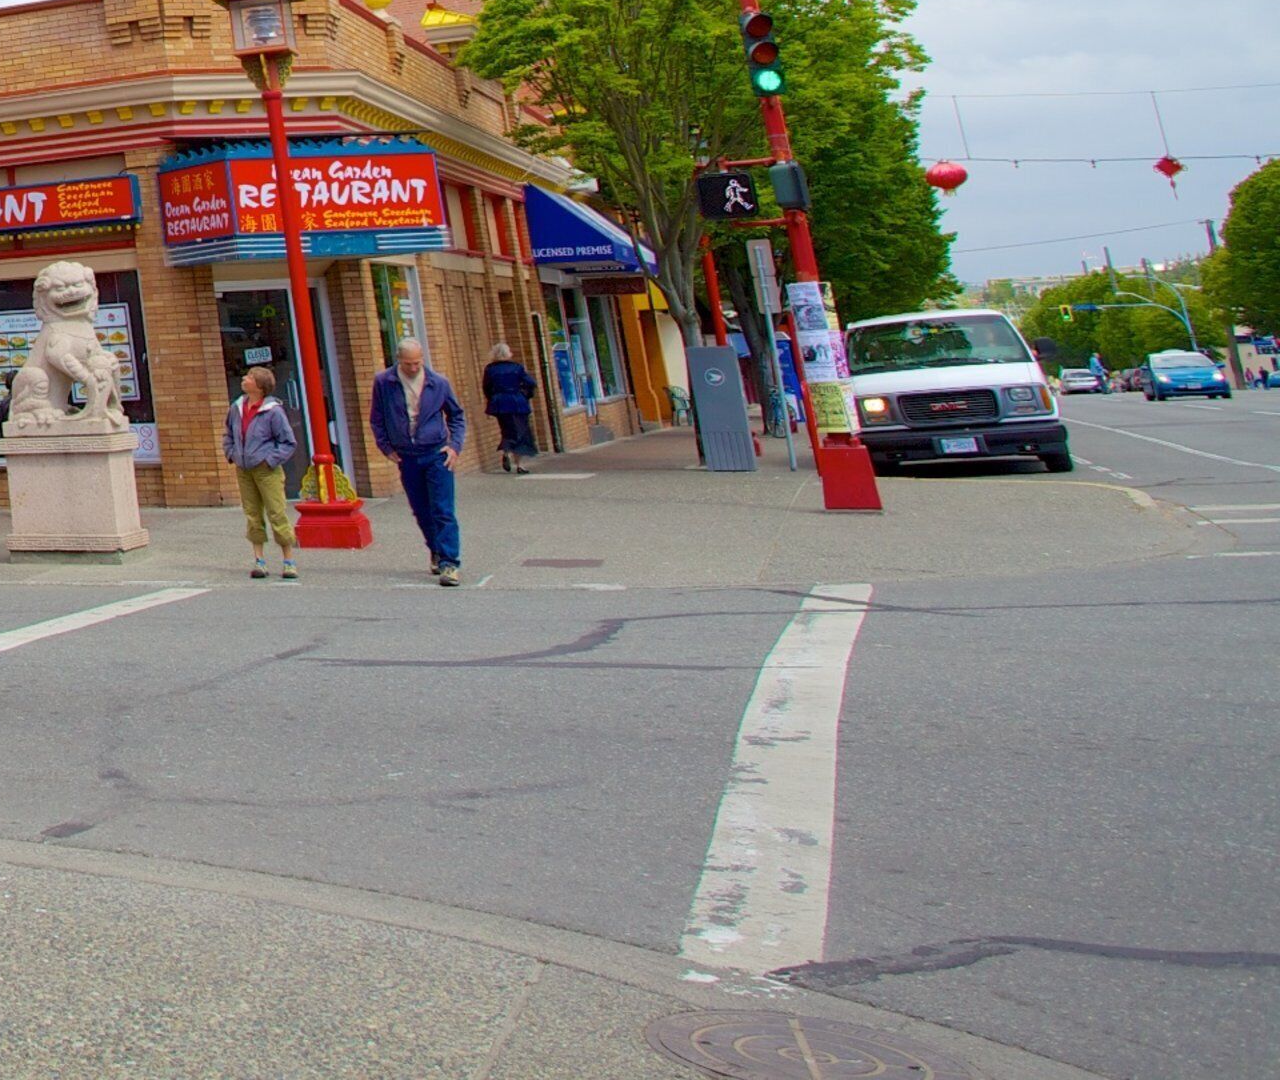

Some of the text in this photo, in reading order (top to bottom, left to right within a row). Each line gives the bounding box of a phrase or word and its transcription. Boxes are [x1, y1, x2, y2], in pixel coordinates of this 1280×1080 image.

[329, 160, 391, 181] Garden
[59, 198, 99, 209] Seafood
[239, 178, 427, 209] RETAURANT
[165, 194, 227, 218] Ocean Garden
[167, 212, 229, 237] RESTAURANT
[241, 213, 319, 233] 海園家
[324, 217, 369, 228] Seafood
[532, 244, 613, 258] LICENSED PREMISE
